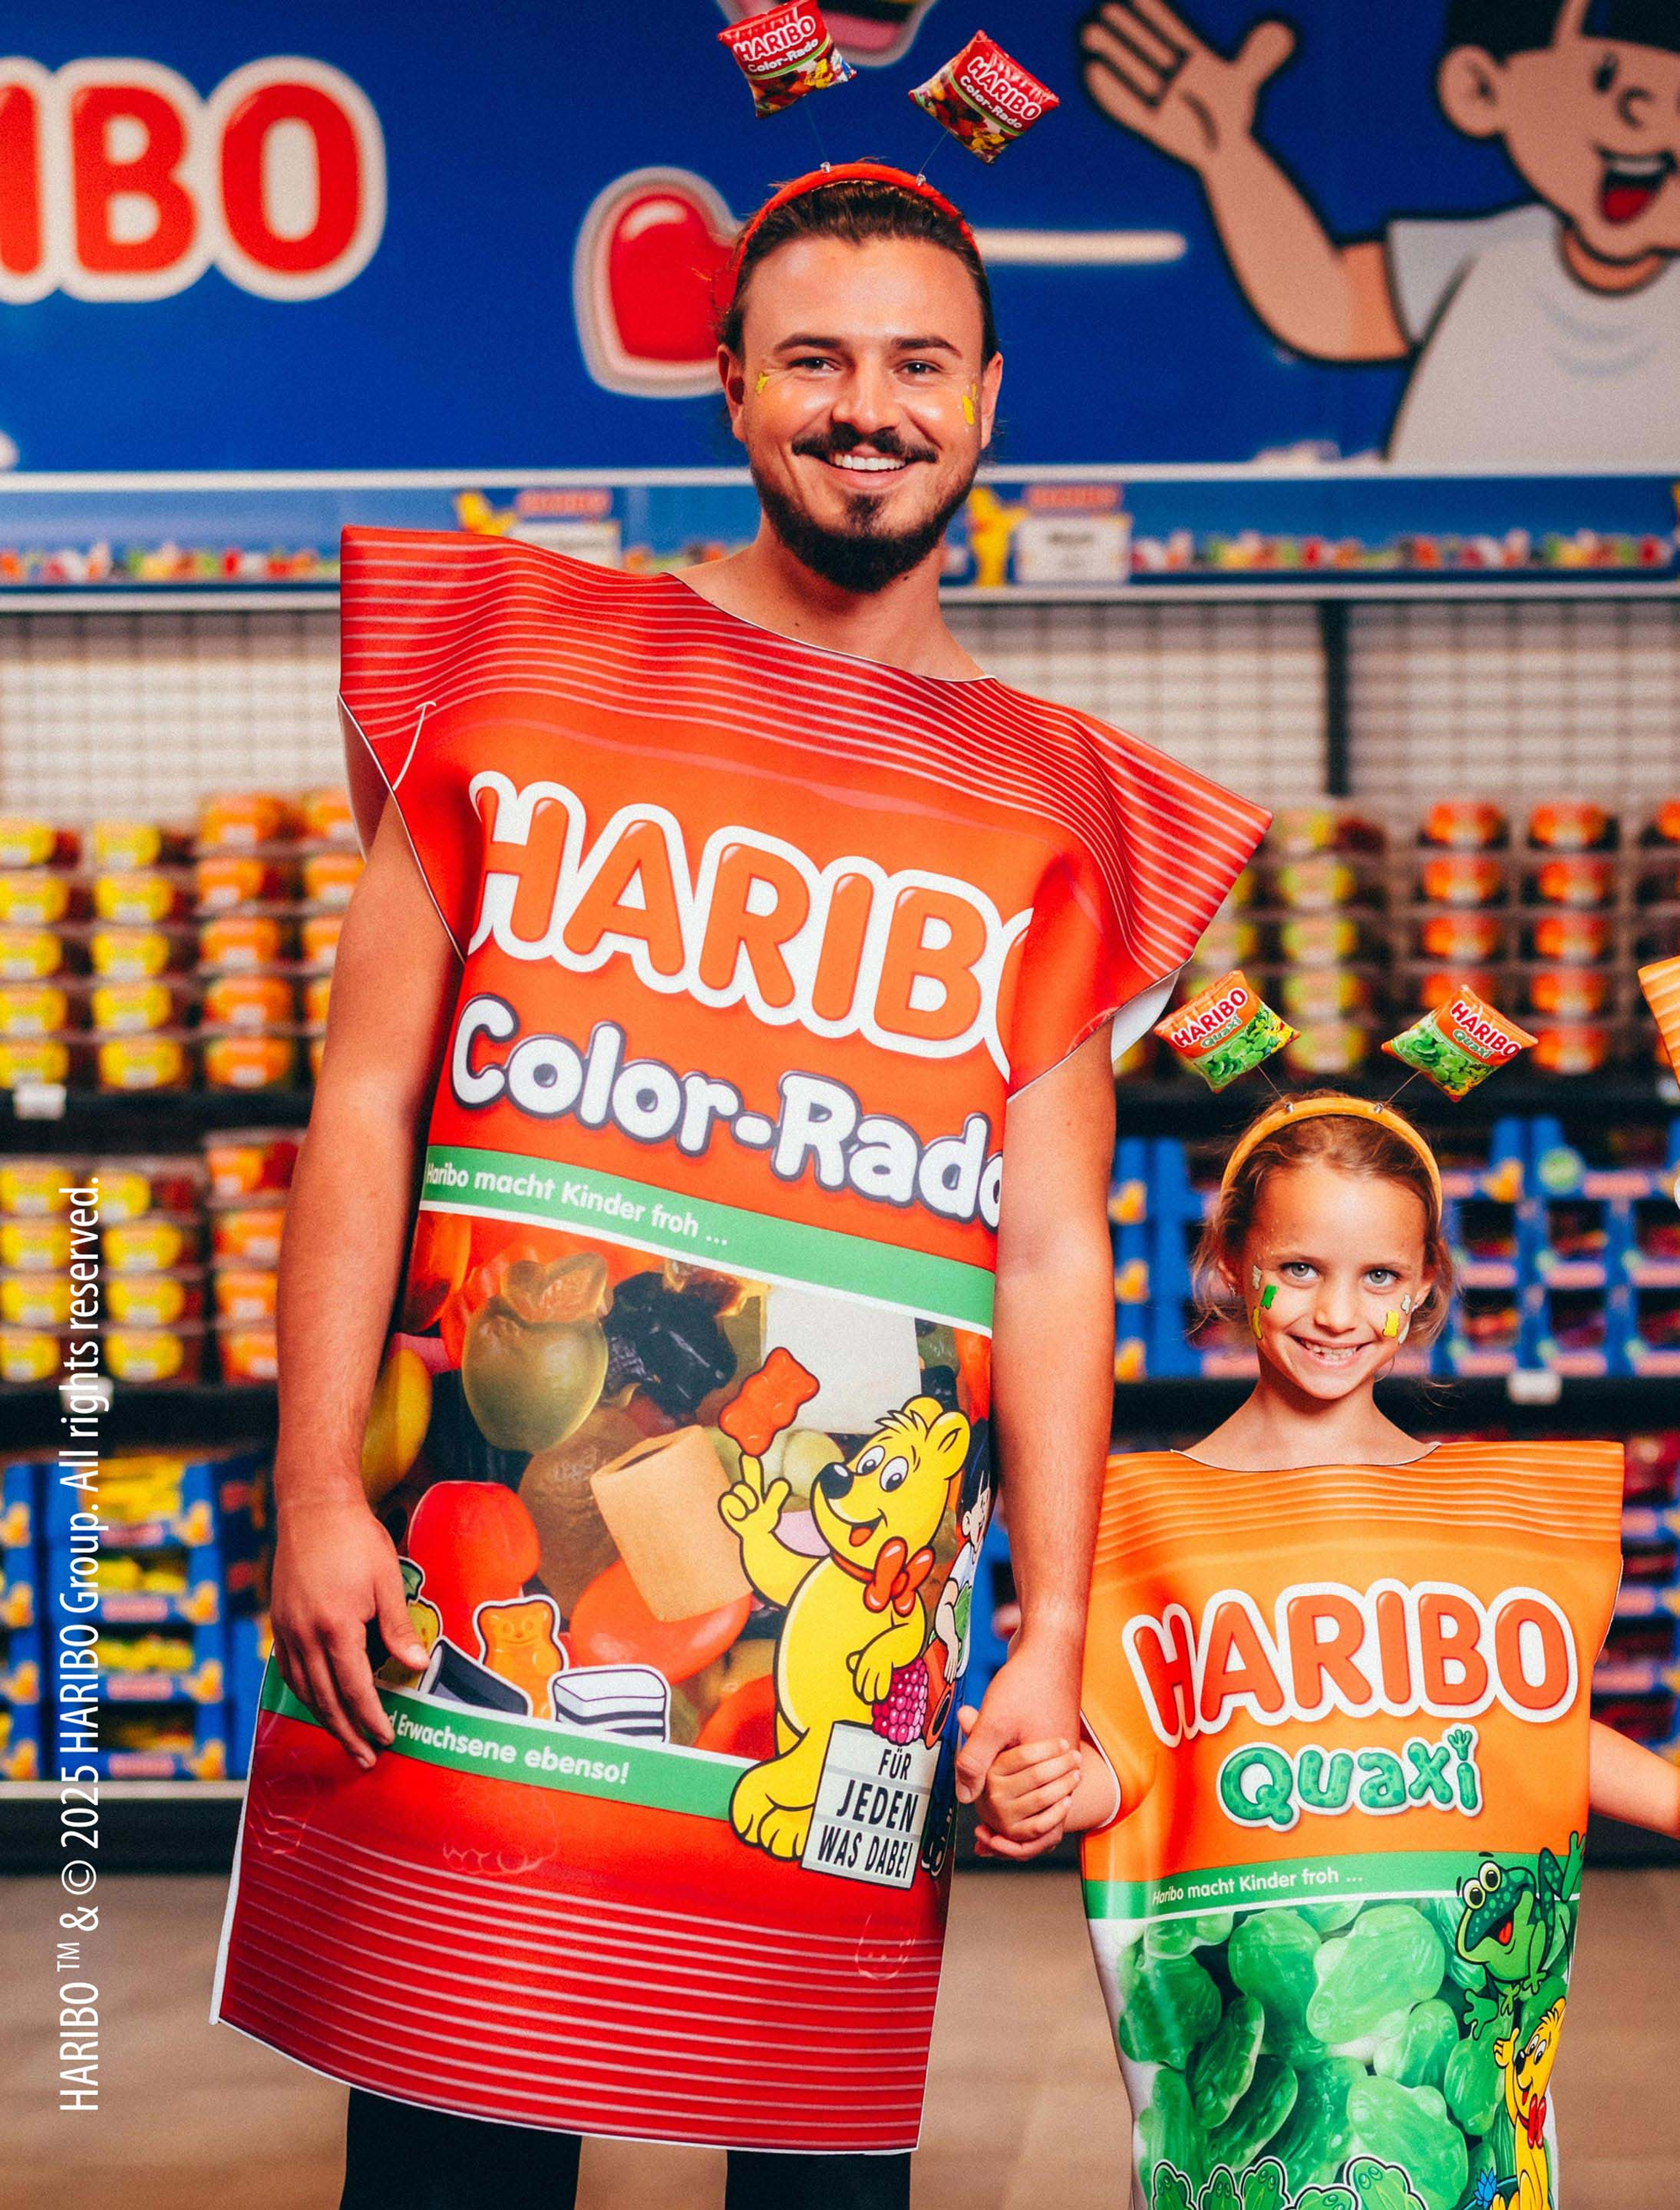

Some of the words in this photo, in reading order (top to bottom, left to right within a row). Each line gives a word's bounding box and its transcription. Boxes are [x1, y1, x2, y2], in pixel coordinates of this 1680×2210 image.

[733, 16, 816, 62] HARIBO
[747, 38, 820, 73] Color-Rado
[959, 75, 1022, 130] Color-Rado
[967, 56, 1042, 122] HARIBO
[1172, 987, 1248, 1047] HARIBO
[1200, 1015, 1242, 1048] Quaxi
[1449, 1000, 1522, 1057] HARIBO
[1452, 1029, 1494, 1058] Quaxi
[426, 1162, 470, 1188] Haribo
[474, 1172, 556, 1200] macht
[560, 1180, 646, 1223] Kinder
[651, 1203, 699, 1239] froh
[1121, 1578, 1578, 1748] HARIBO
[396, 1714, 517, 1764] Erwachsene
[524, 1746, 630, 1785] ebenso!
[878, 1747, 912, 1781] FÜR
[1216, 1723, 1483, 1832] Quaxi
[836, 1779, 919, 1833] JEDEN
[816, 1824, 863, 1869] WAS
[864, 1835, 913, 1879] DABEI
[1152, 1887, 1184, 1905] Haribo
[1188, 1877, 1235, 1898] macht
[1239, 1871, 1297, 1892] Kinder
[1301, 1866, 1339, 1886] froh
